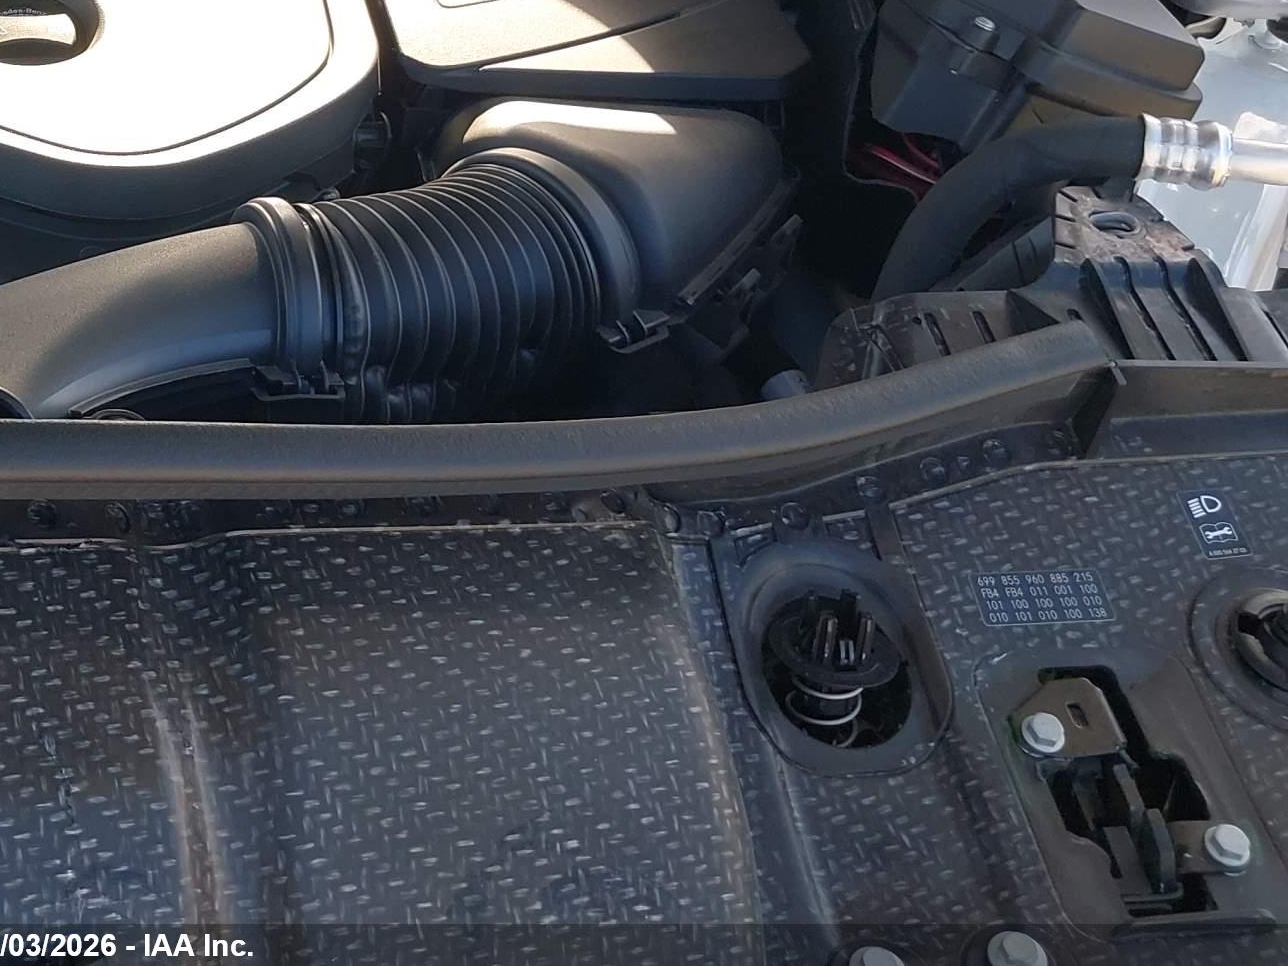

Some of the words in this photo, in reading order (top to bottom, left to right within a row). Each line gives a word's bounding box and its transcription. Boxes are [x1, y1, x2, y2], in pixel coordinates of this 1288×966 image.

[977, 576, 995, 587] 699
[1001, 575, 1020, 586] 855
[1025, 574, 1045, 584] 960
[1049, 573, 1069, 584] 885
[1073, 572, 1093, 583] 215
[980, 588, 999, 599] FB4
[1005, 587, 1024, 598] FB4
[1029, 586, 1048, 596] 011
[1054, 585, 1072, 595] 001
[1079, 583, 1098, 594] 100
[986, 600, 1004, 611] 101
[1011, 599, 1030, 609] 100
[1035, 598, 1054, 608] 100
[1059, 596, 1078, 607] 100
[1083, 595, 1103, 606] 010
[989, 612, 1009, 623] 010
[1015, 611, 1033, 622] 101
[1038, 610, 1058, 620] 010
[1064, 608, 1083, 619] 100
[1088, 607, 1107, 618] 138
